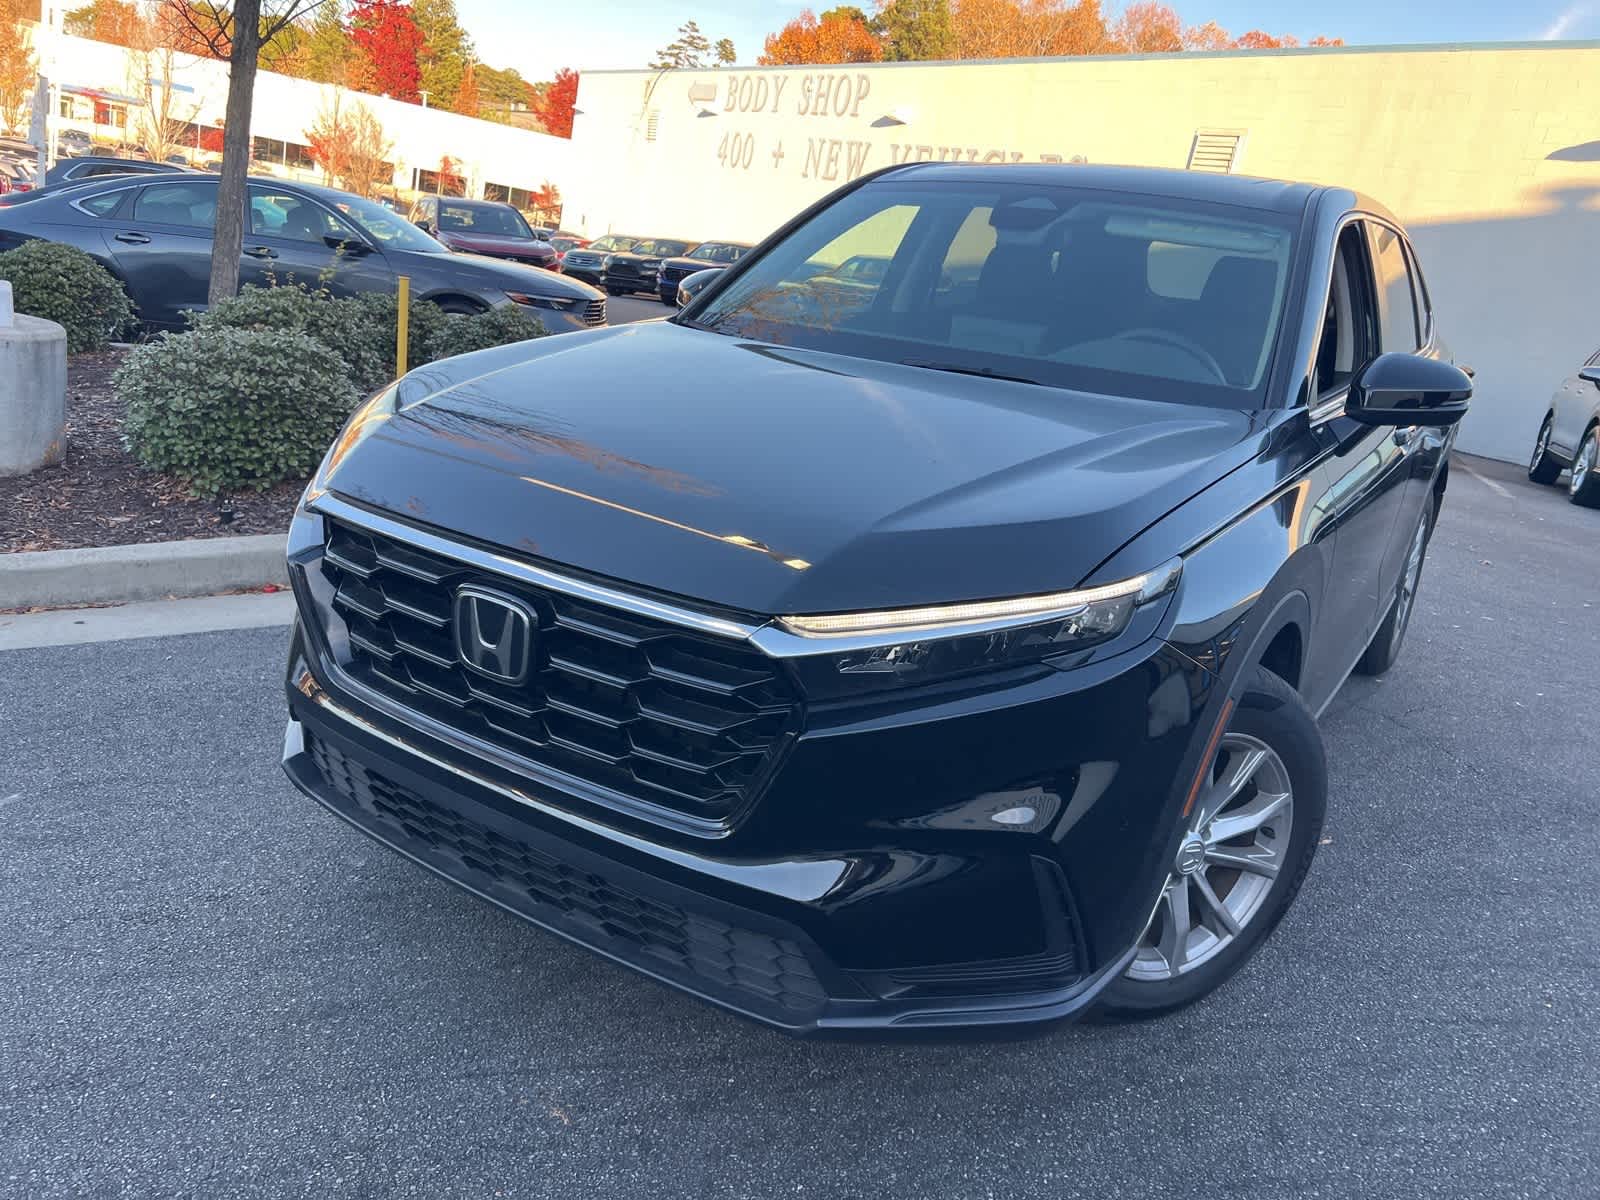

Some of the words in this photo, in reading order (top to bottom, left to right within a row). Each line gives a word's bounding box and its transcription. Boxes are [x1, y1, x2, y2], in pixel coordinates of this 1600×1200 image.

[724, 74, 789, 113] BODY
[798, 73, 871, 117] SHOP
[717, 131, 754, 171] 400
[801, 137, 872, 182] NEW
